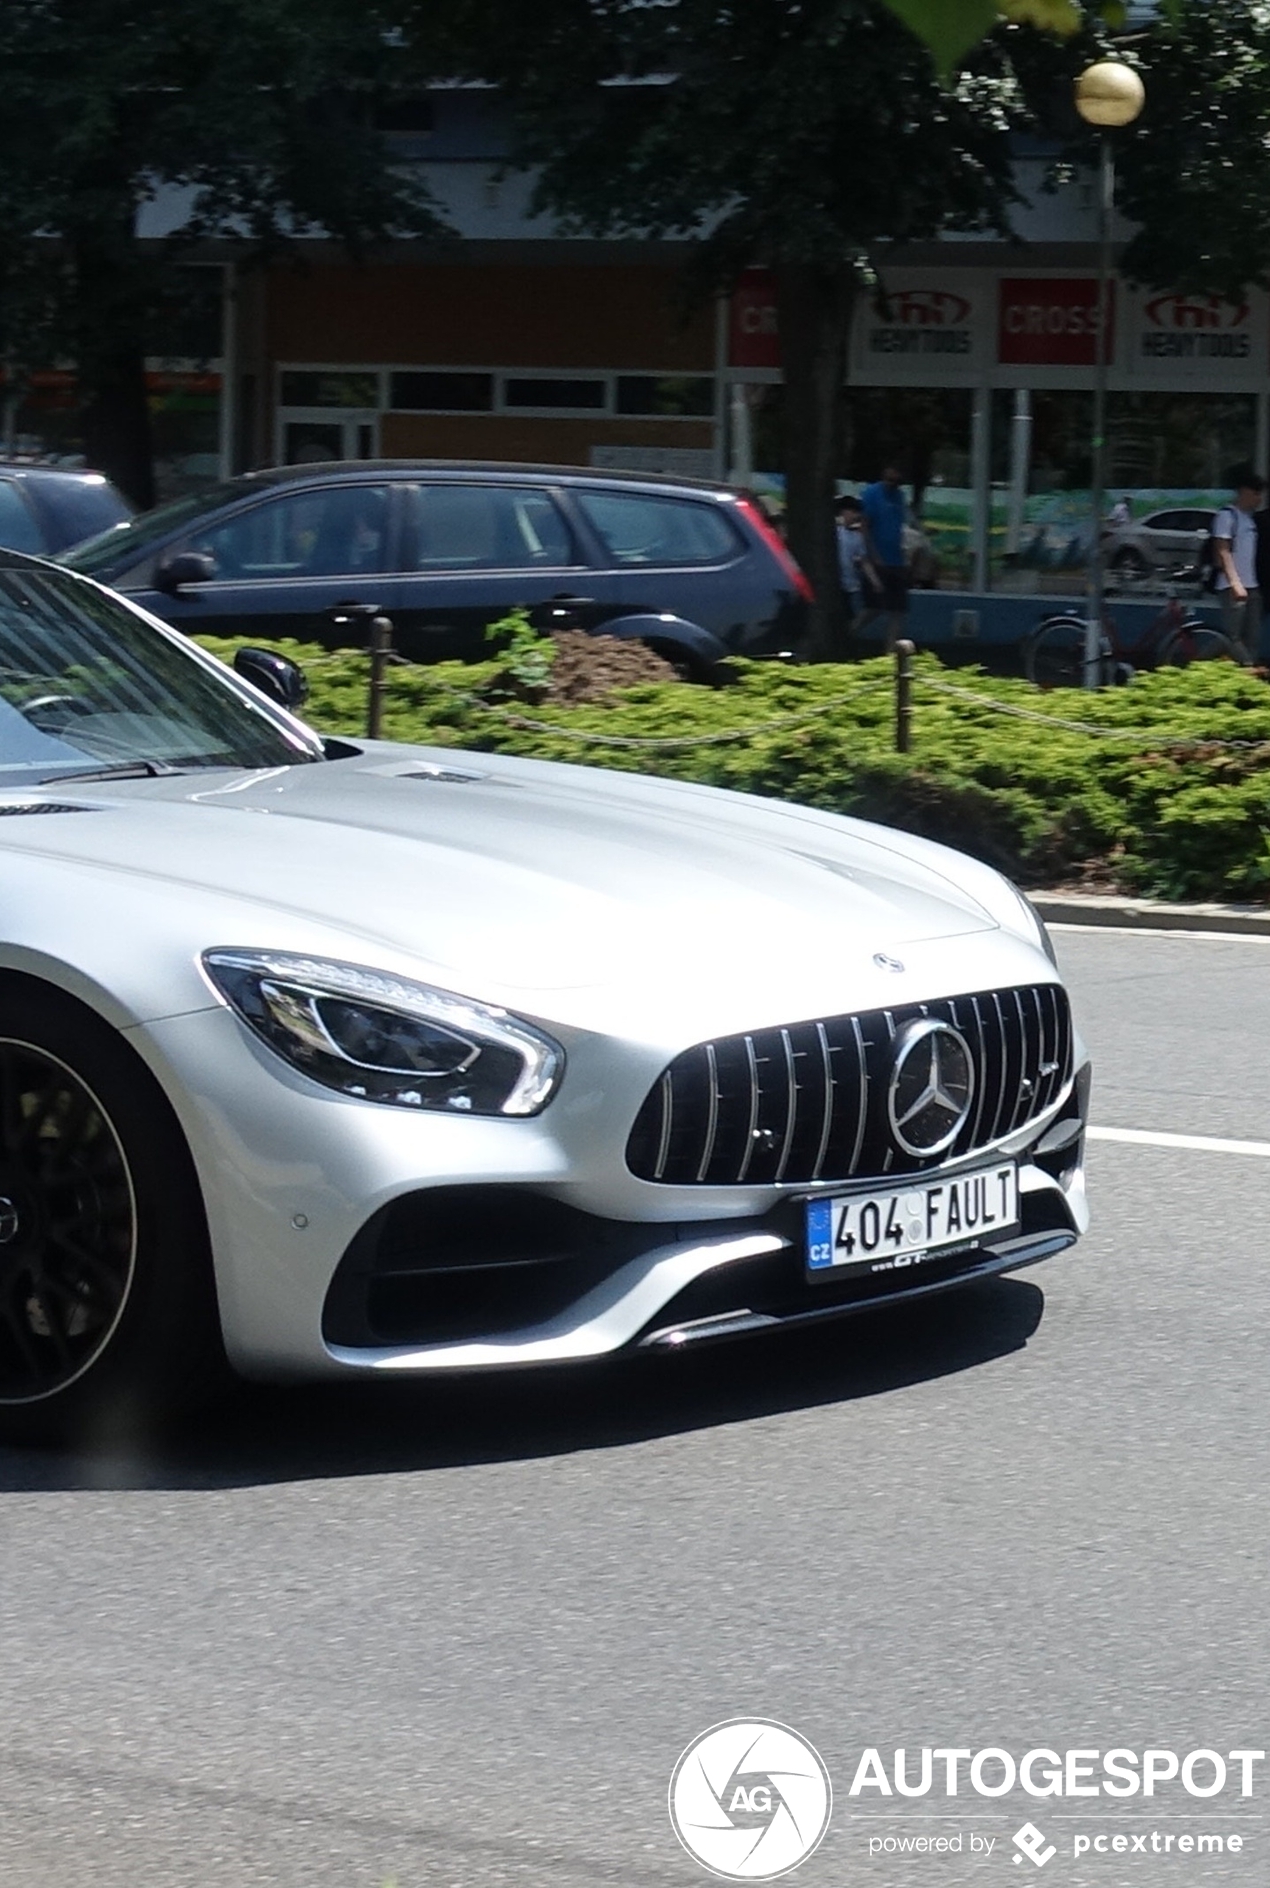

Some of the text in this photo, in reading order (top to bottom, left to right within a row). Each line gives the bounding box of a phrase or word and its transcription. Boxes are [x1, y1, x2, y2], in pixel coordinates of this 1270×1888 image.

[870, 328, 969, 354] HEAVY TOOLS
[1142, 332, 1250, 359] HEAVY TOOLS
[835, 1197, 904, 1256] 404
[926, 1170, 1011, 1240] FAULT
[810, 1243, 830, 1261] CZ
